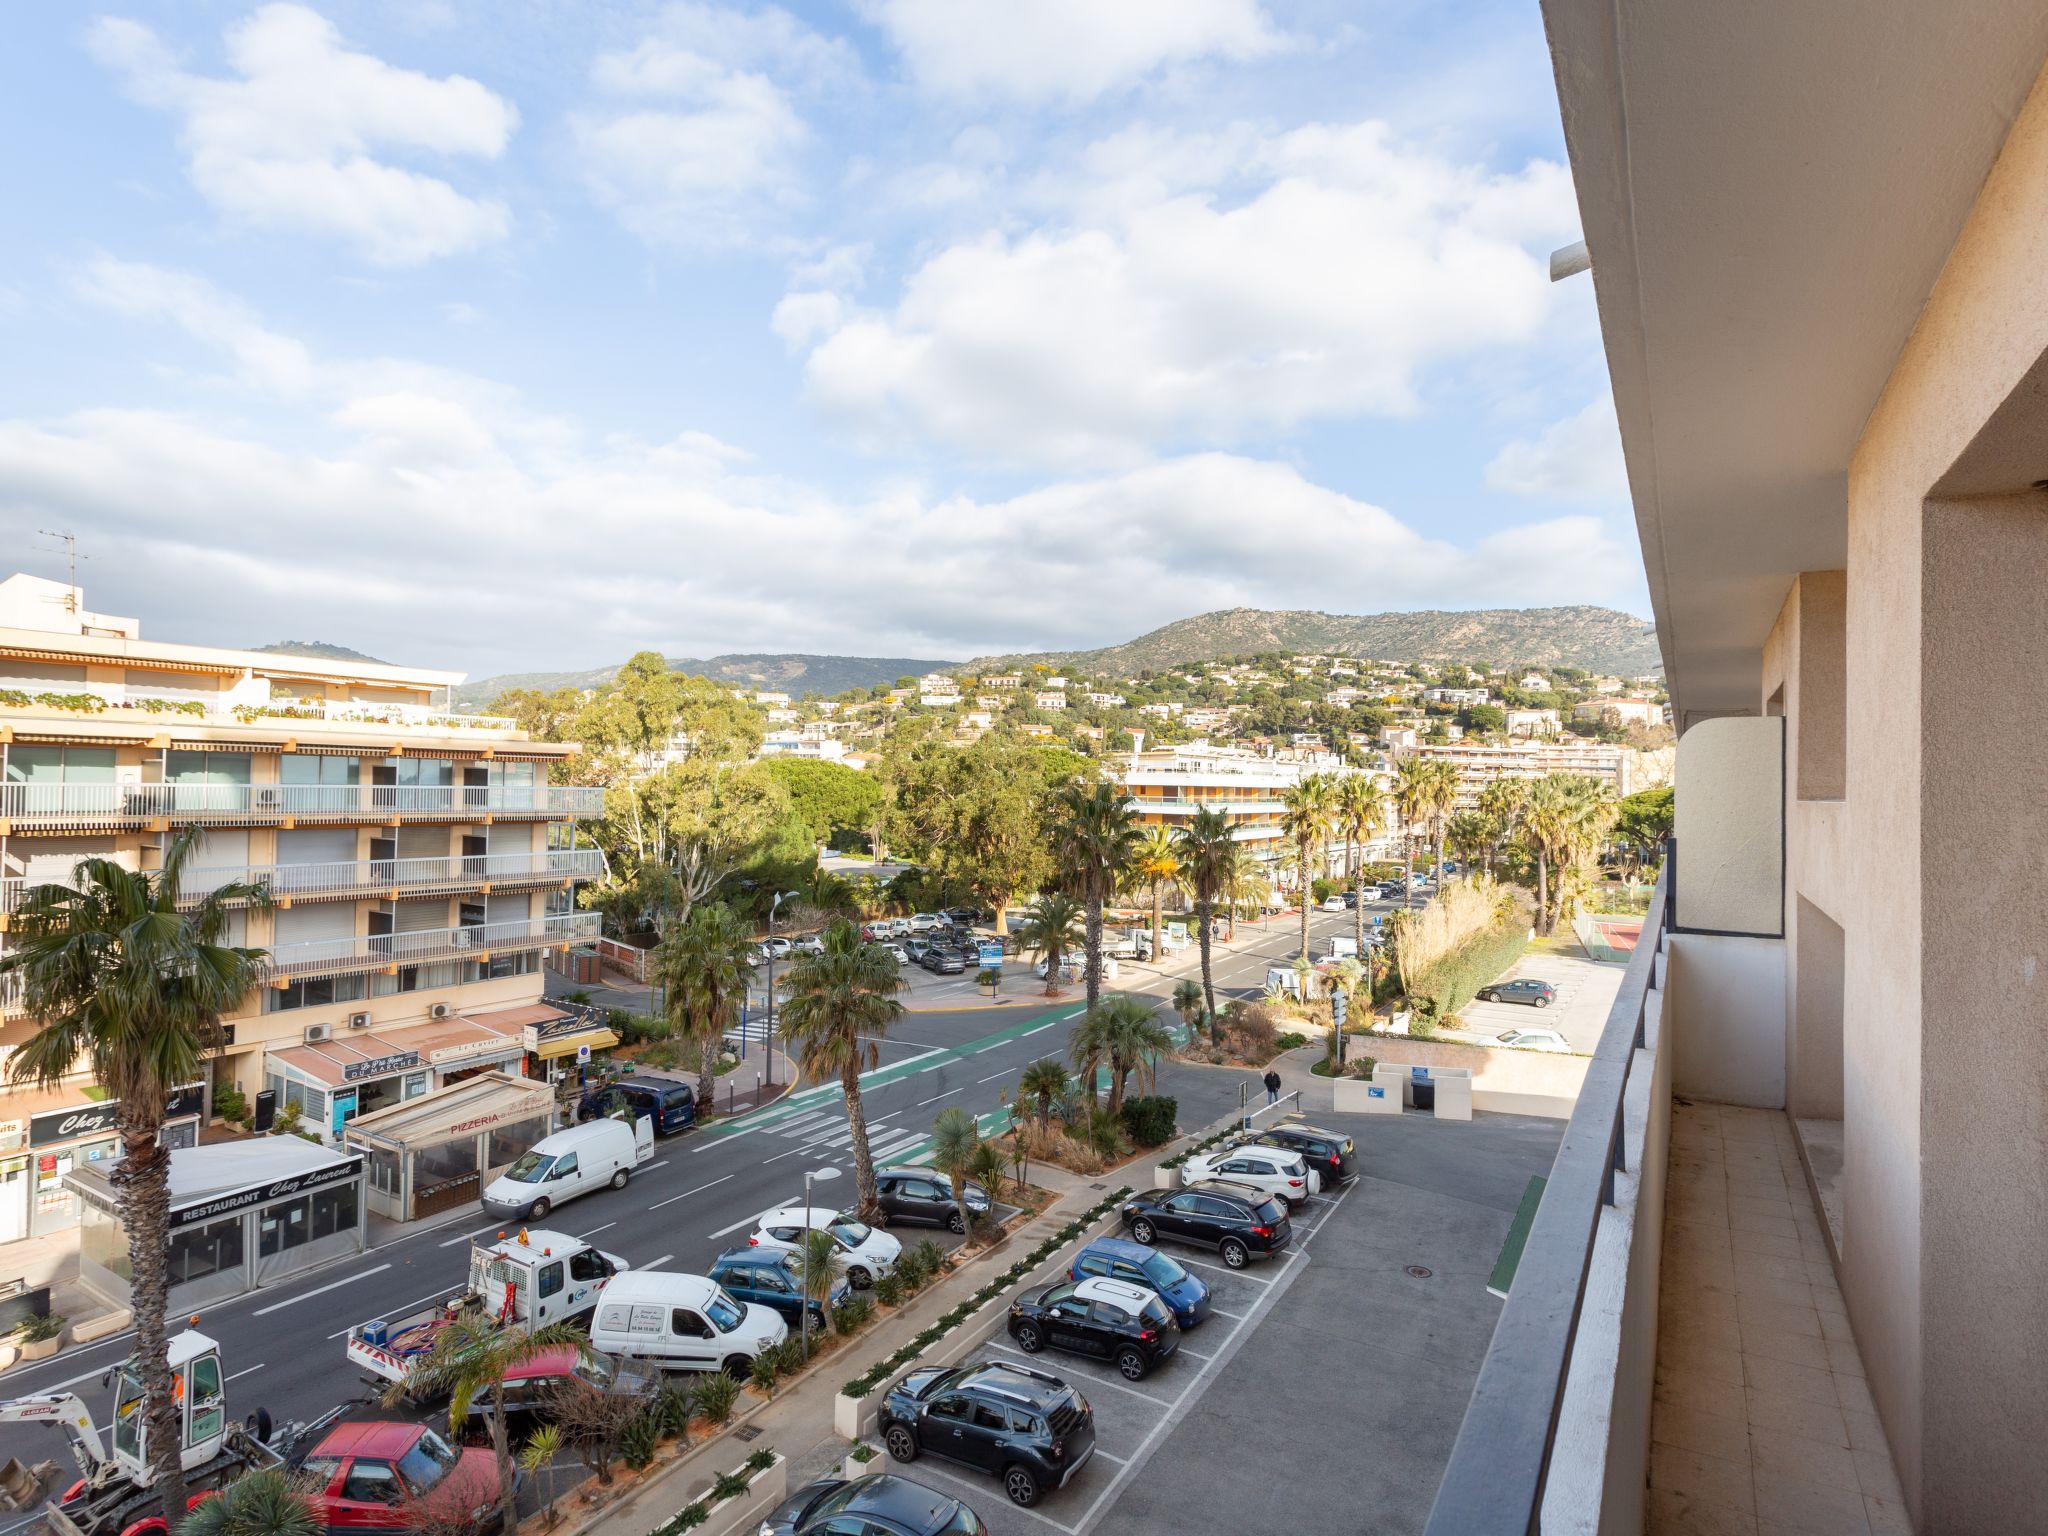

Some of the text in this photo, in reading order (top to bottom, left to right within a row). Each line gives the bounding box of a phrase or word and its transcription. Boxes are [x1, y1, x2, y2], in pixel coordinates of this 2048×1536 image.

[351, 1070, 365, 1078] DU
[58, 1113, 105, 1135] Chez
[450, 1113, 500, 1135] PIZZERIA
[182, 1165, 351, 1222] RESTAURANT Chez Laurent
